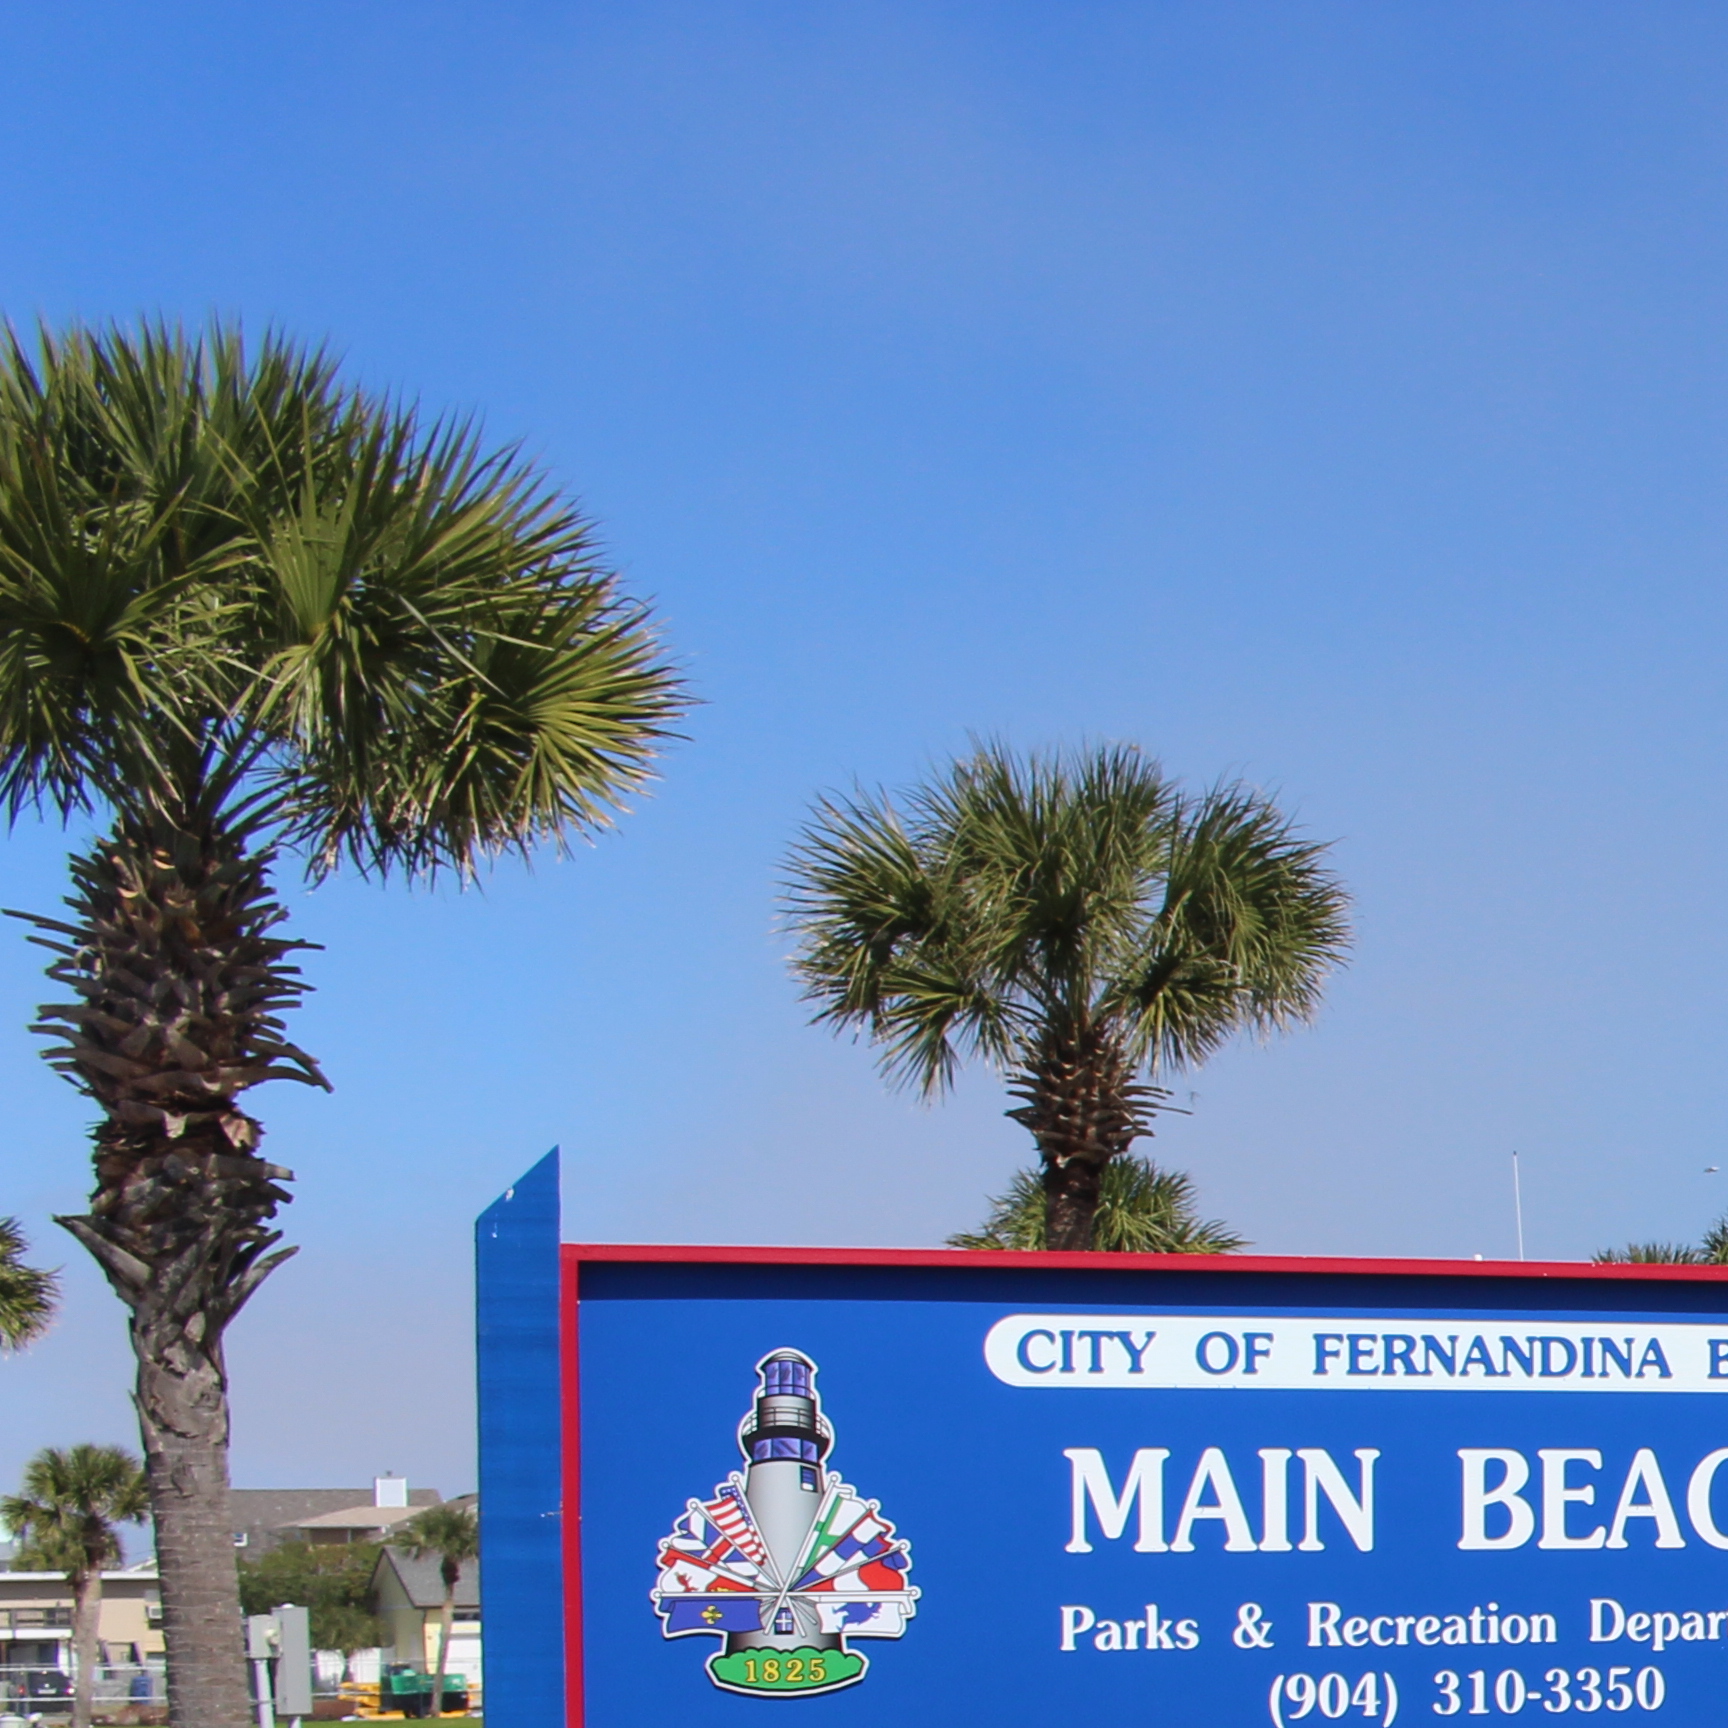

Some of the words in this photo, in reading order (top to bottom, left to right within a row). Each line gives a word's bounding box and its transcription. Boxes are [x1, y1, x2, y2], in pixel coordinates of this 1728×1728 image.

[1015, 1327, 1157, 1376] CITY
[1194, 1329, 1275, 1376] OF
[1311, 1331, 1673, 1381] FERNANDINA
[1062, 1446, 1381, 1553] MAIN
[1059, 1602, 1200, 1652] Parks
[1231, 1602, 1275, 1650] &
[1306, 1601, 1558, 1648] Recreation
[745, 1658, 827, 1683] 1825
[1431, 1665, 1666, 1716] 310-3350
